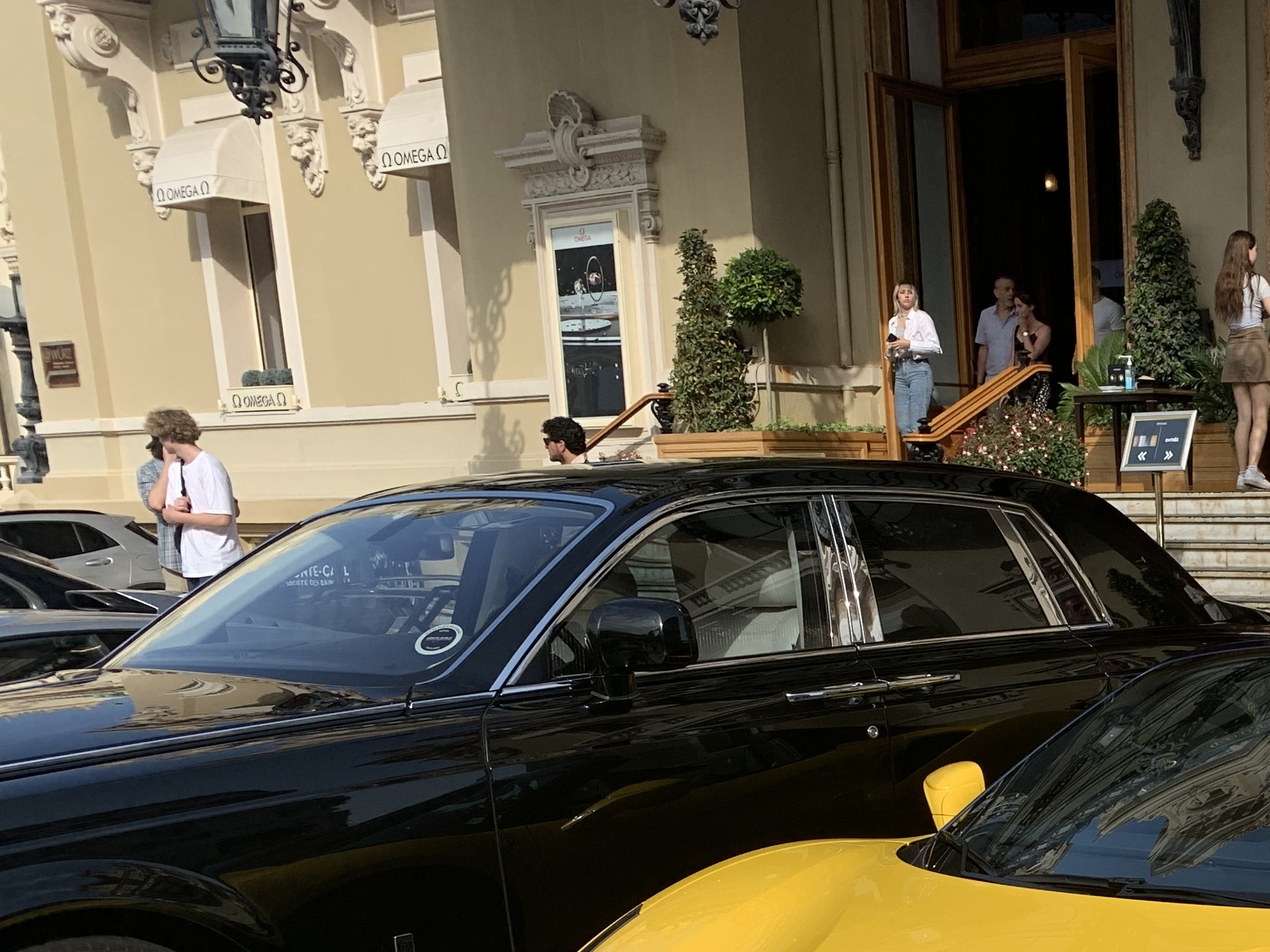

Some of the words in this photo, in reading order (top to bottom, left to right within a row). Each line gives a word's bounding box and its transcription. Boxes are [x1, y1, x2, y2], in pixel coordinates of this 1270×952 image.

[394, 148, 434, 166] OMEGA
[167, 185, 199, 201] OMEGA
[243, 394, 276, 408] OMEGA
